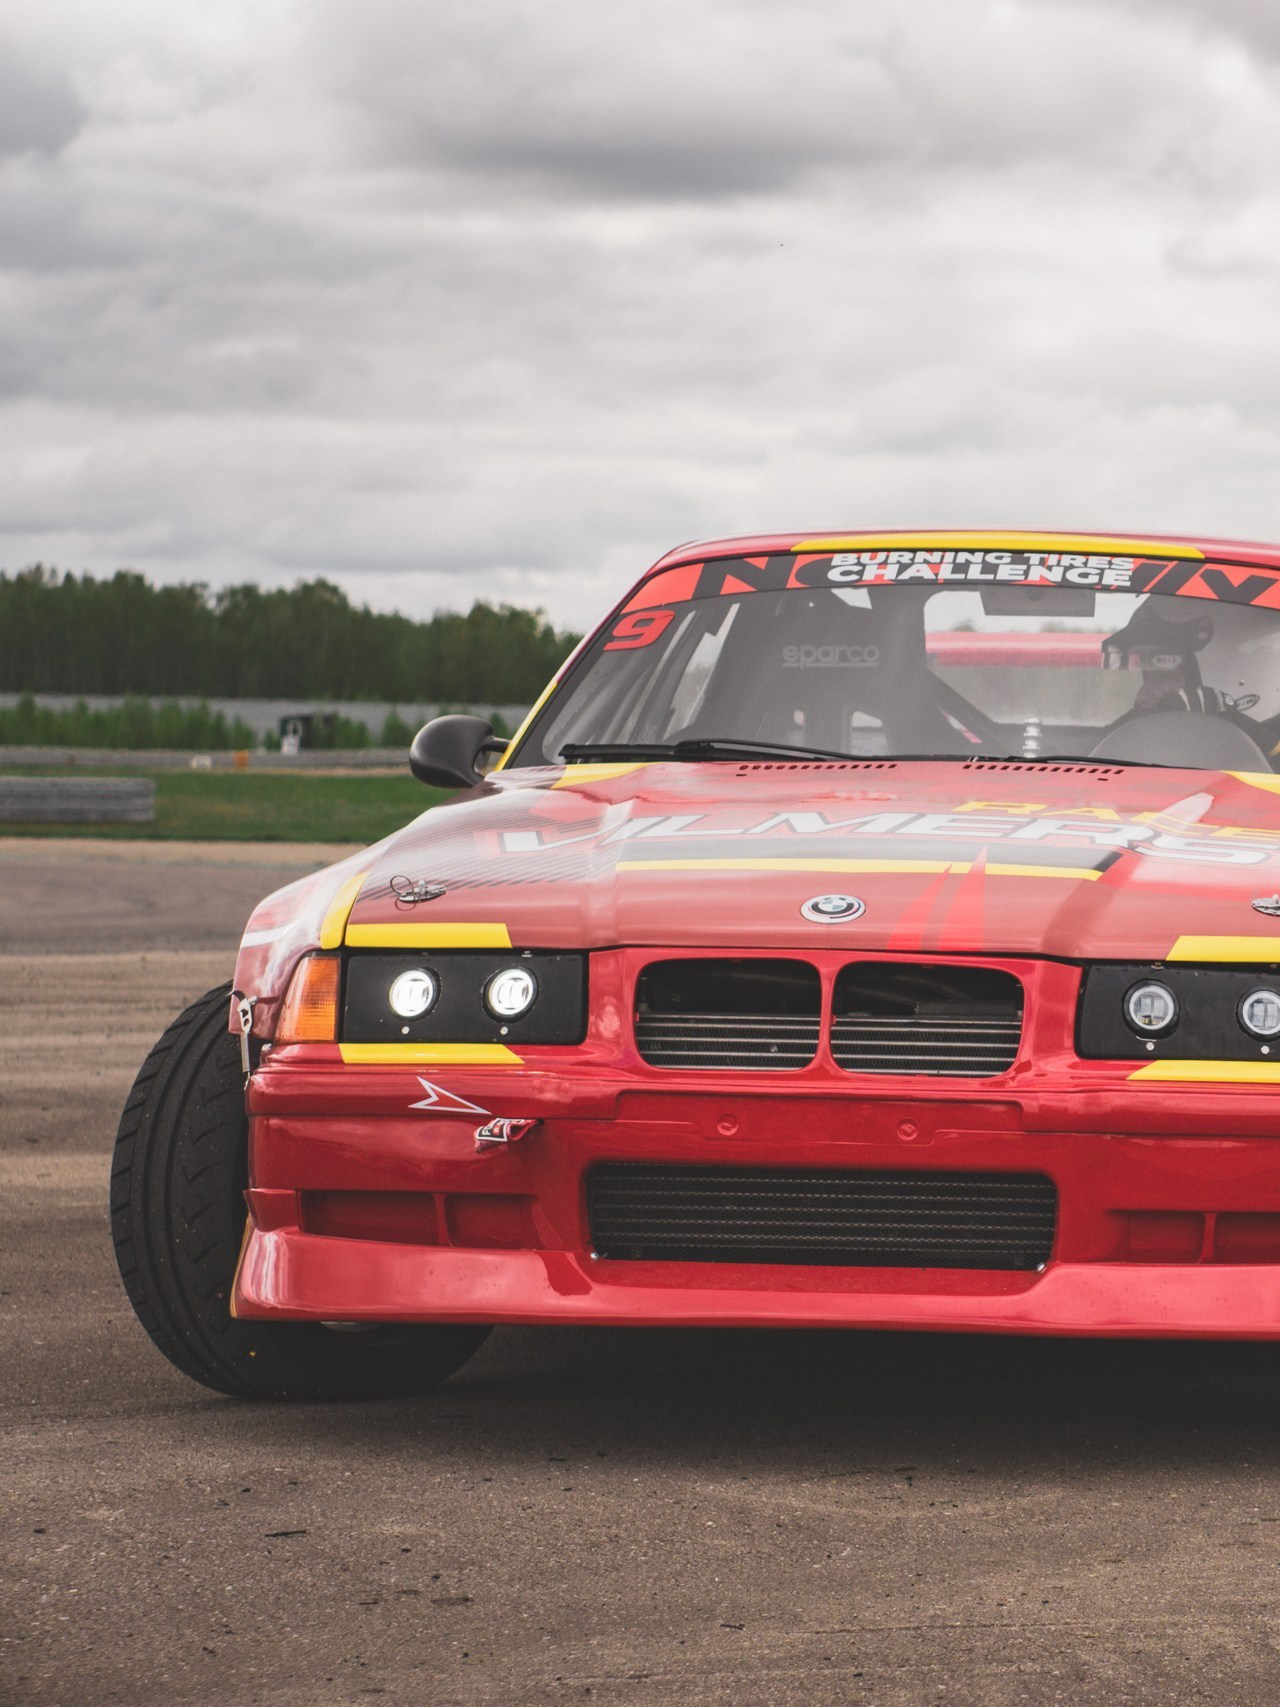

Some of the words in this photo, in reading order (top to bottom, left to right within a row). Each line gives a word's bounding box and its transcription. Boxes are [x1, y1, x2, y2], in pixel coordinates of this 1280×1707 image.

[830, 551, 1013, 566] BURNING
[1023, 553, 1135, 570] TIRES
[827, 563, 1133, 587] CHALLENGE
[603, 609, 676, 651] 9
[782, 645, 880, 669] sparco
[499, 810, 1273, 866] VILMERS
